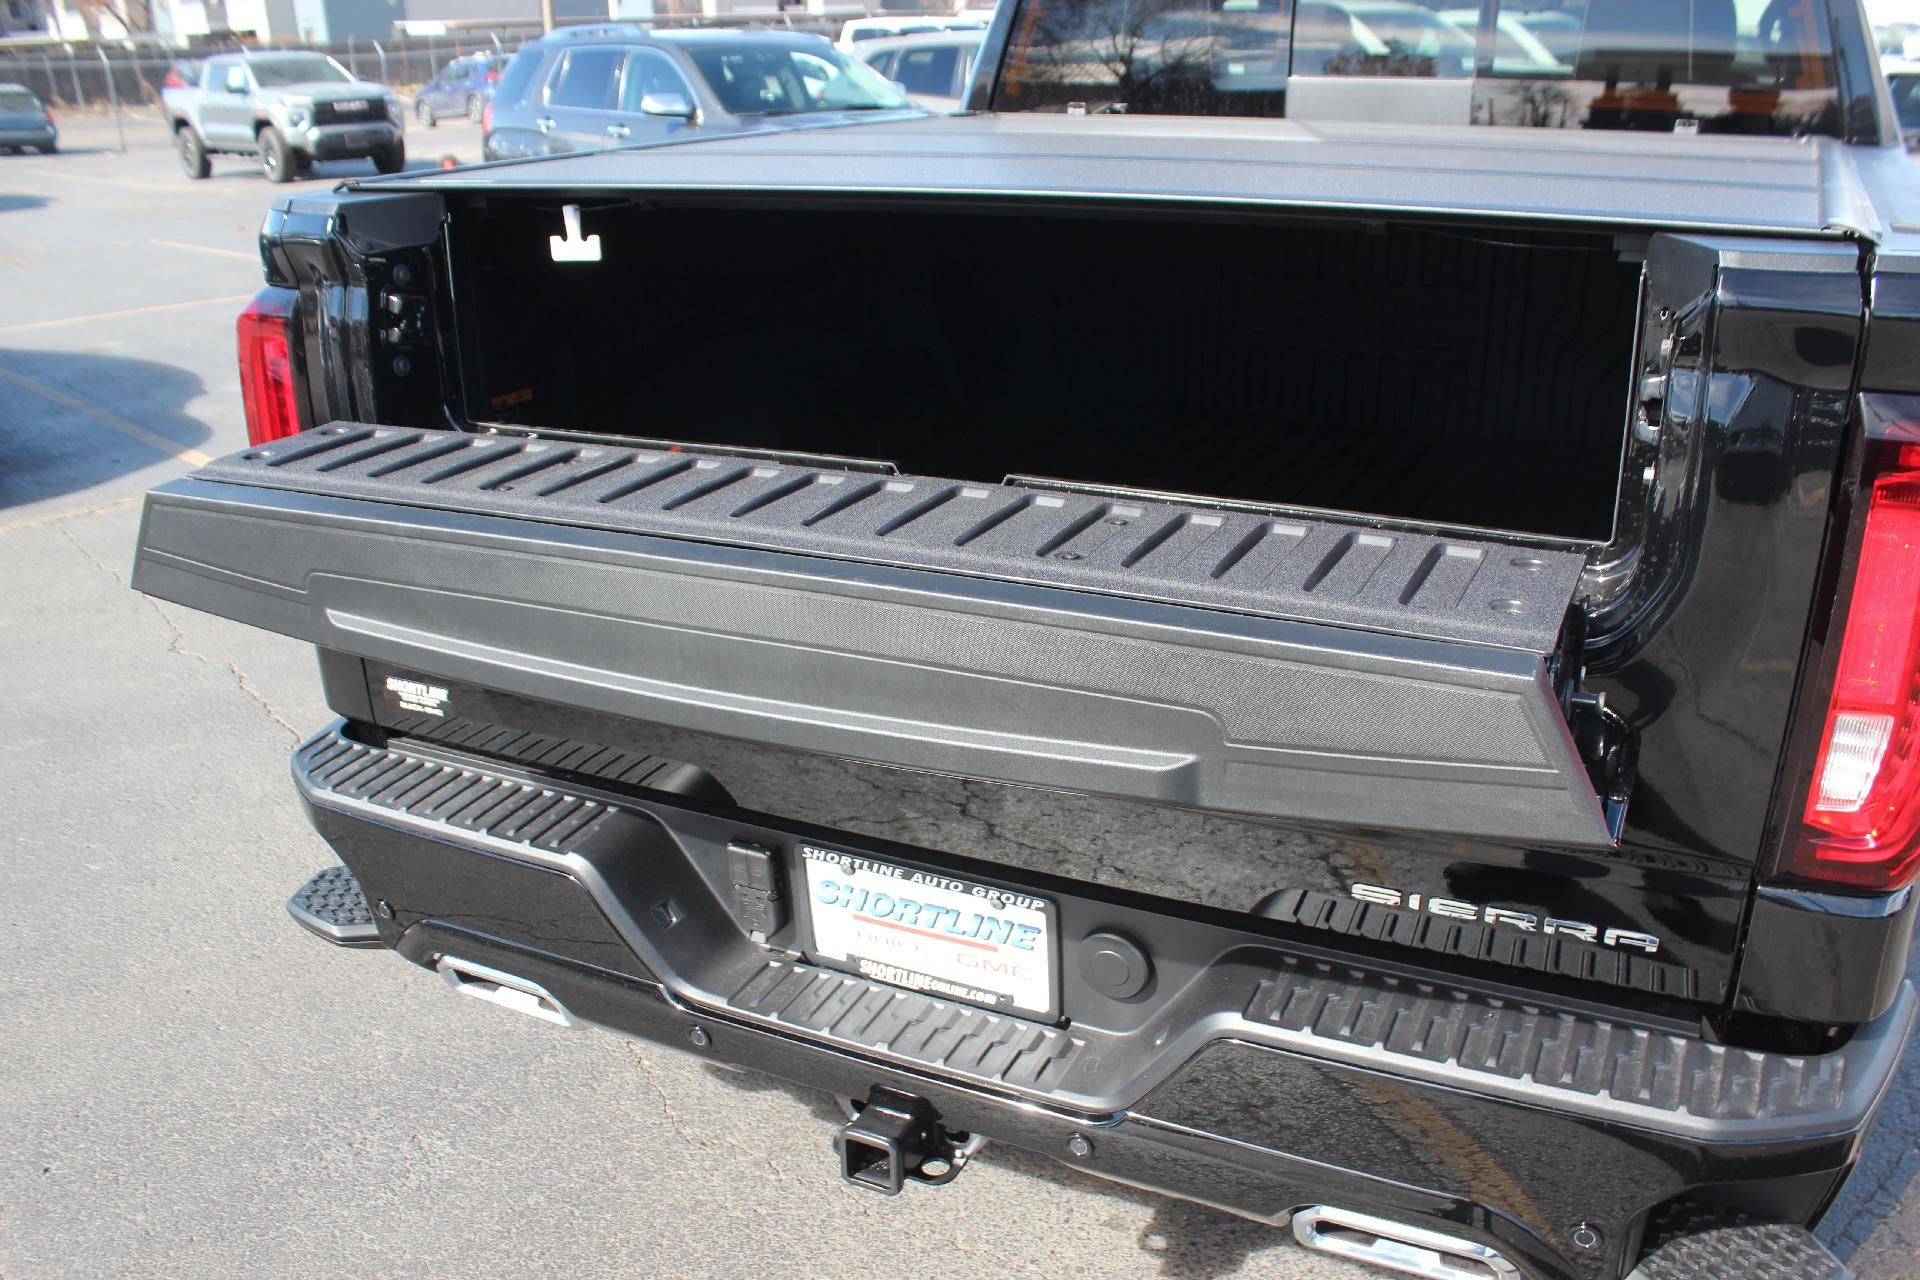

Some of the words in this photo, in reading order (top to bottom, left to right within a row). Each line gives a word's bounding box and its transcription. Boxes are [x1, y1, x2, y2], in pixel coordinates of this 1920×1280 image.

[385, 677, 449, 701] SHORTLINE
[802, 847, 904, 879] SHORTLINE
[910, 873, 963, 893] AUTO
[971, 886, 1045, 911] GROUP
[816, 880, 1041, 951] SHORTLINE
[1351, 882, 1660, 953] SIERRA
[956, 951, 1033, 981] GMC
